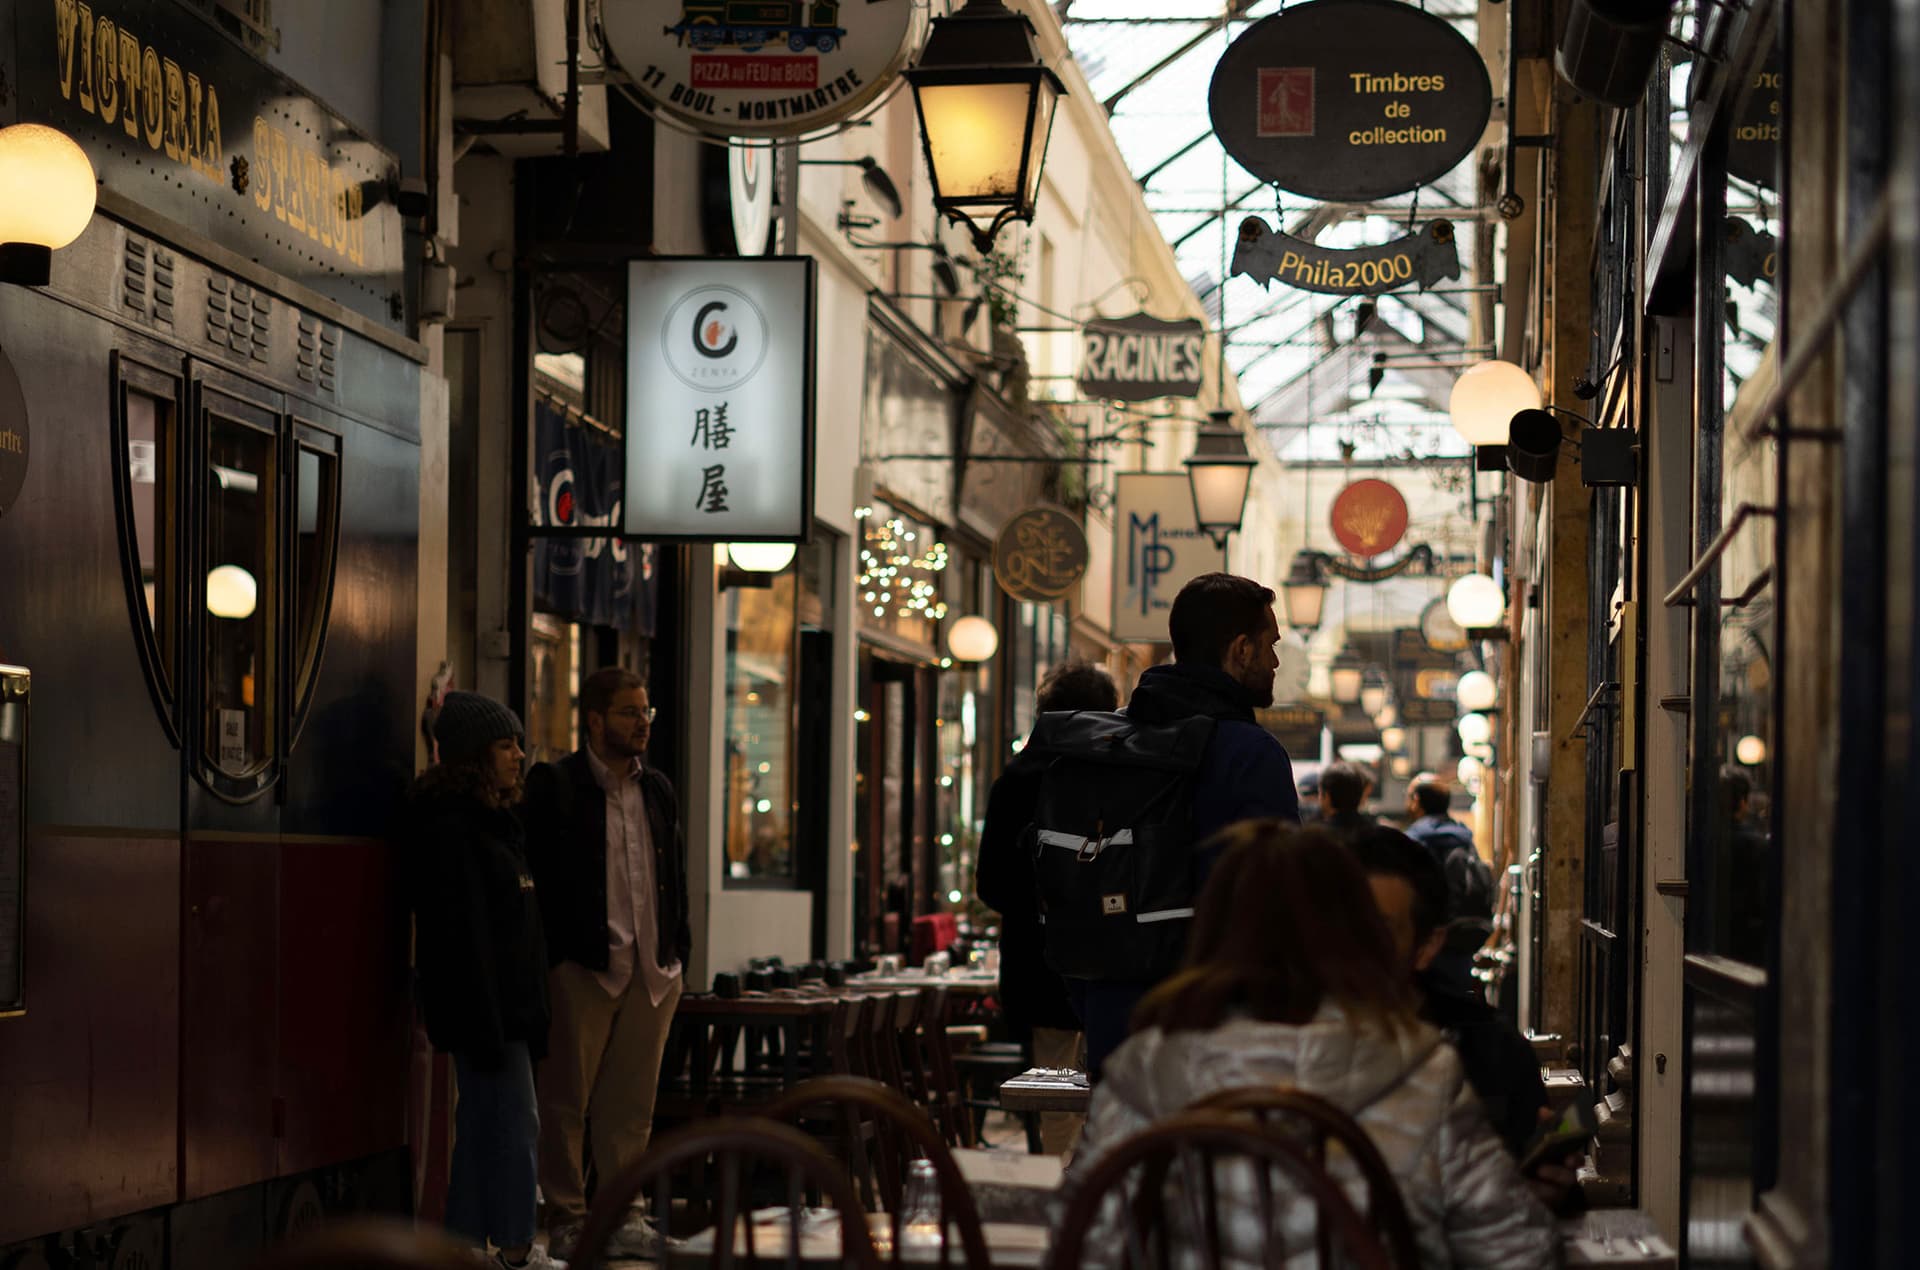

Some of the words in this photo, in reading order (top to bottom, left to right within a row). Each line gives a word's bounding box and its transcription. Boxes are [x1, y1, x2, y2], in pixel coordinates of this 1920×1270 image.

[693, 62, 731, 82] PIZZA
[746, 62, 771, 82] FEU
[784, 61, 816, 82] BOIS
[1349, 72, 1446, 94] Timbres
[641, 65, 667, 89] 11
[669, 82, 716, 115] BOUL
[738, 68, 864, 121] MONTMARTRE
[1383, 101, 1411, 119] de
[55, 0, 225, 186] VICTORIA
[253, 115, 364, 267] STATION
[1348, 125, 1447, 146] collection
[1277, 250, 1412, 288] Phila2000
[1080, 333, 1202, 381] RACINES
[690, 401, 737, 514] 膳屋
